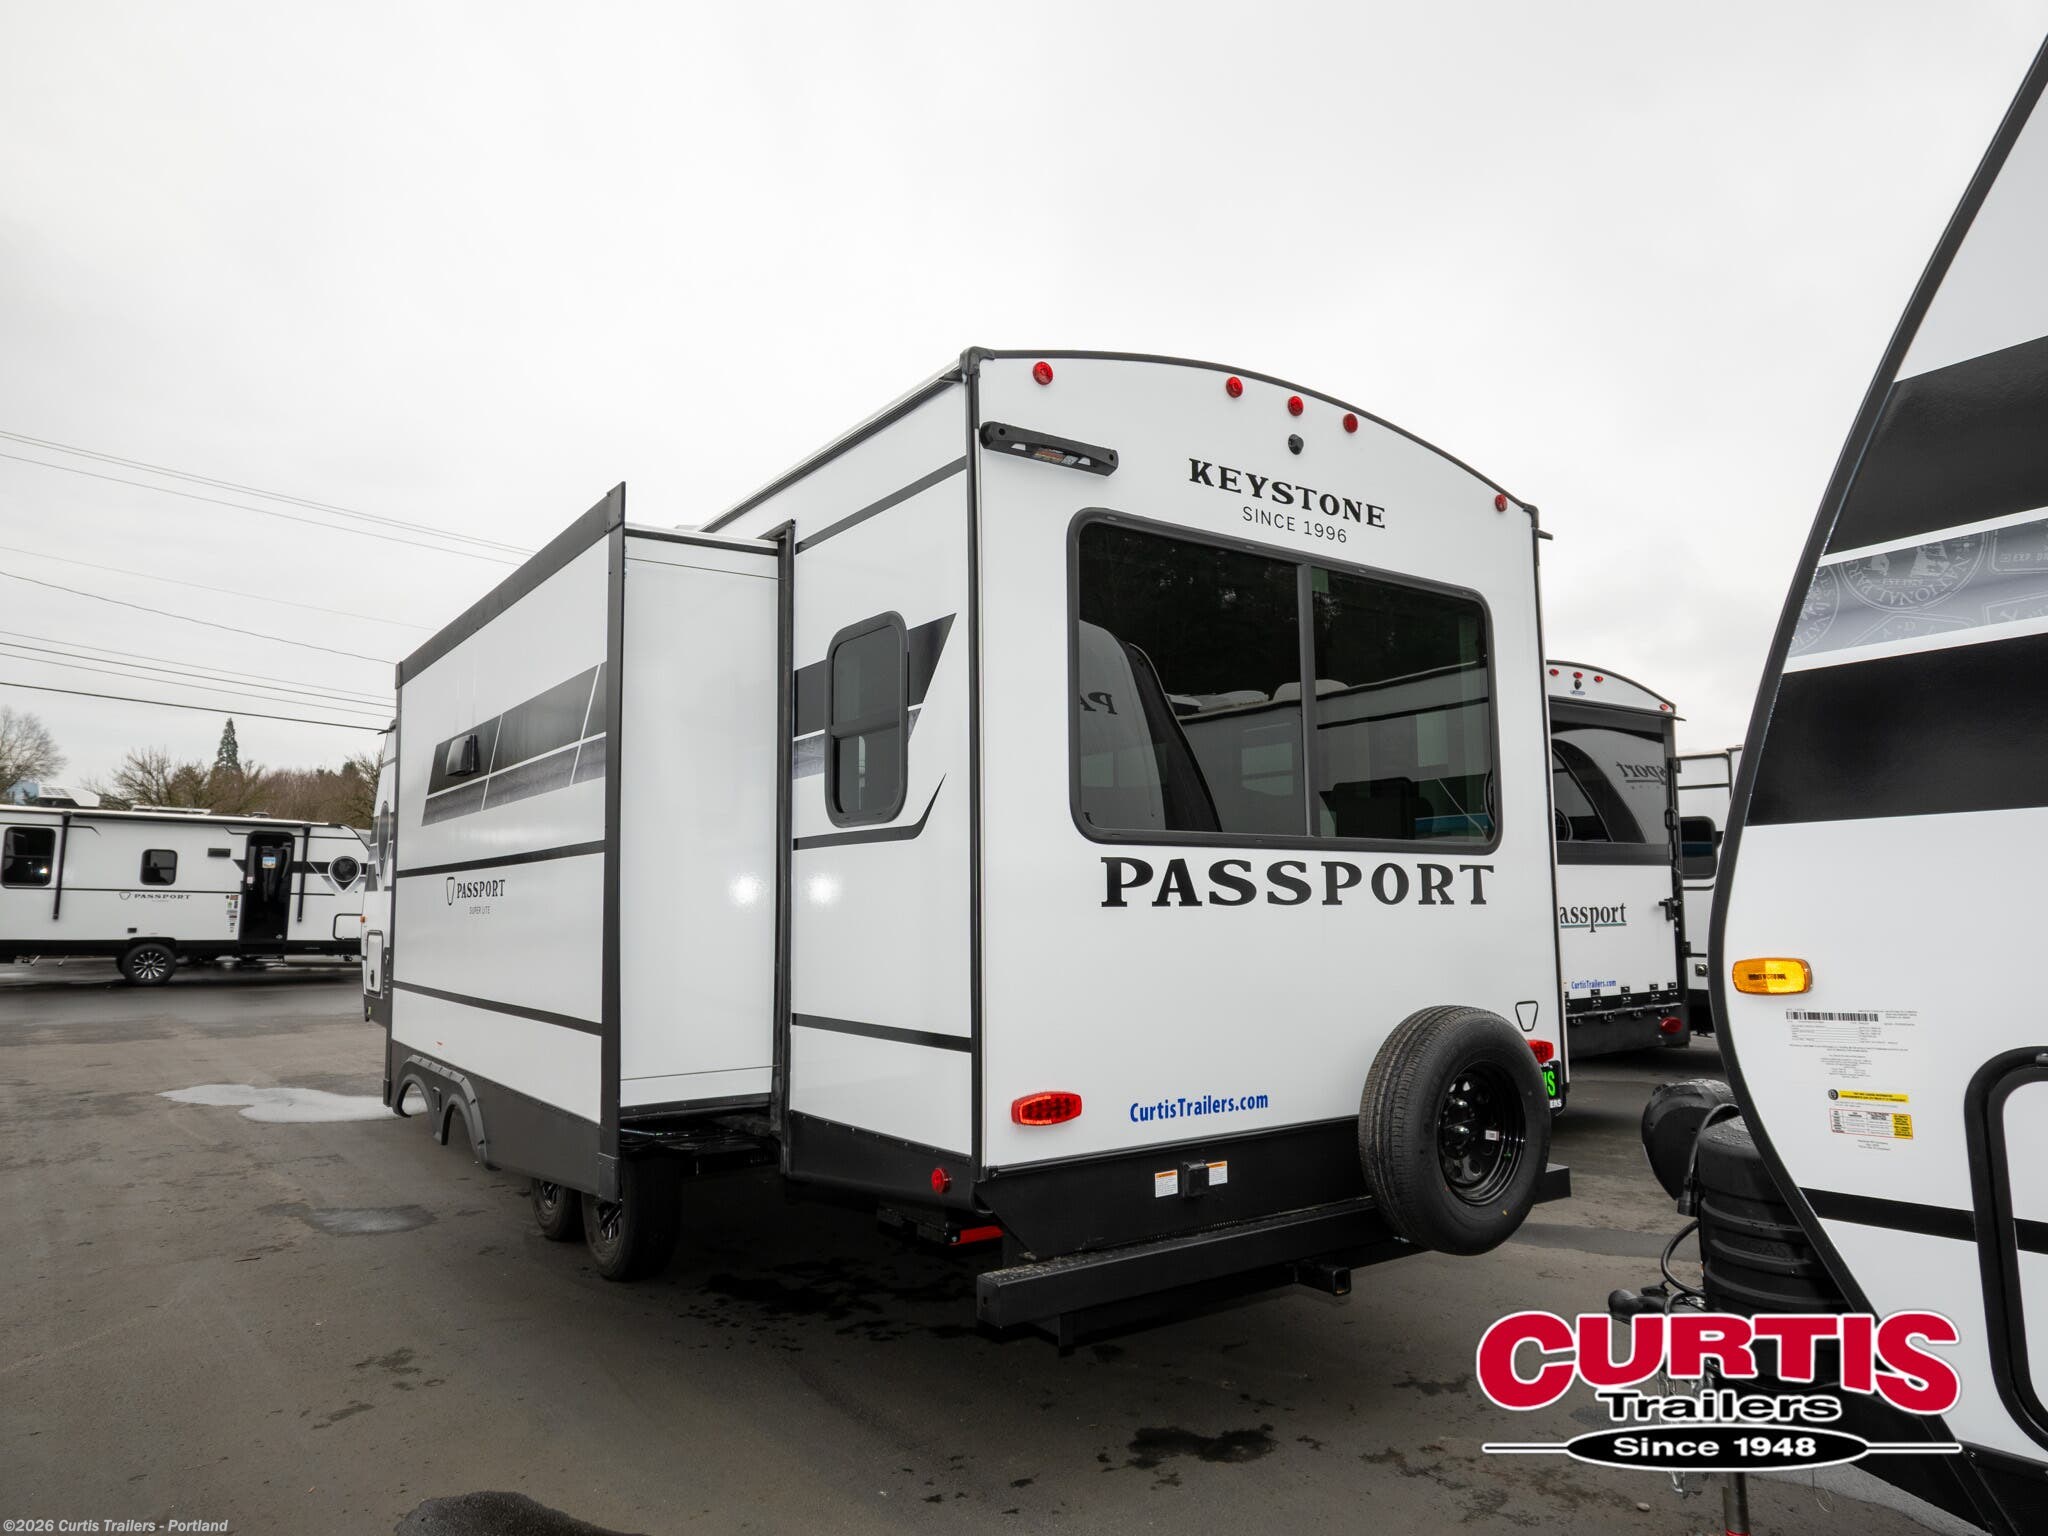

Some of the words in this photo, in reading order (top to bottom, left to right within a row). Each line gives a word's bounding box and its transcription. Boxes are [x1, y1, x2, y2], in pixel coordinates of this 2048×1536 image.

[1188, 457, 1387, 529] KEYSTONE
[1242, 505, 1297, 533] SINCE
[1302, 519, 1348, 544] 1996
[456, 879, 506, 899] PASSPORT
[1100, 856, 1495, 908] PASSPORT
[1571, 980, 1617, 990] CurtisTrailers.com
[1130, 1094, 1269, 1122] CurtisTrailers.com
